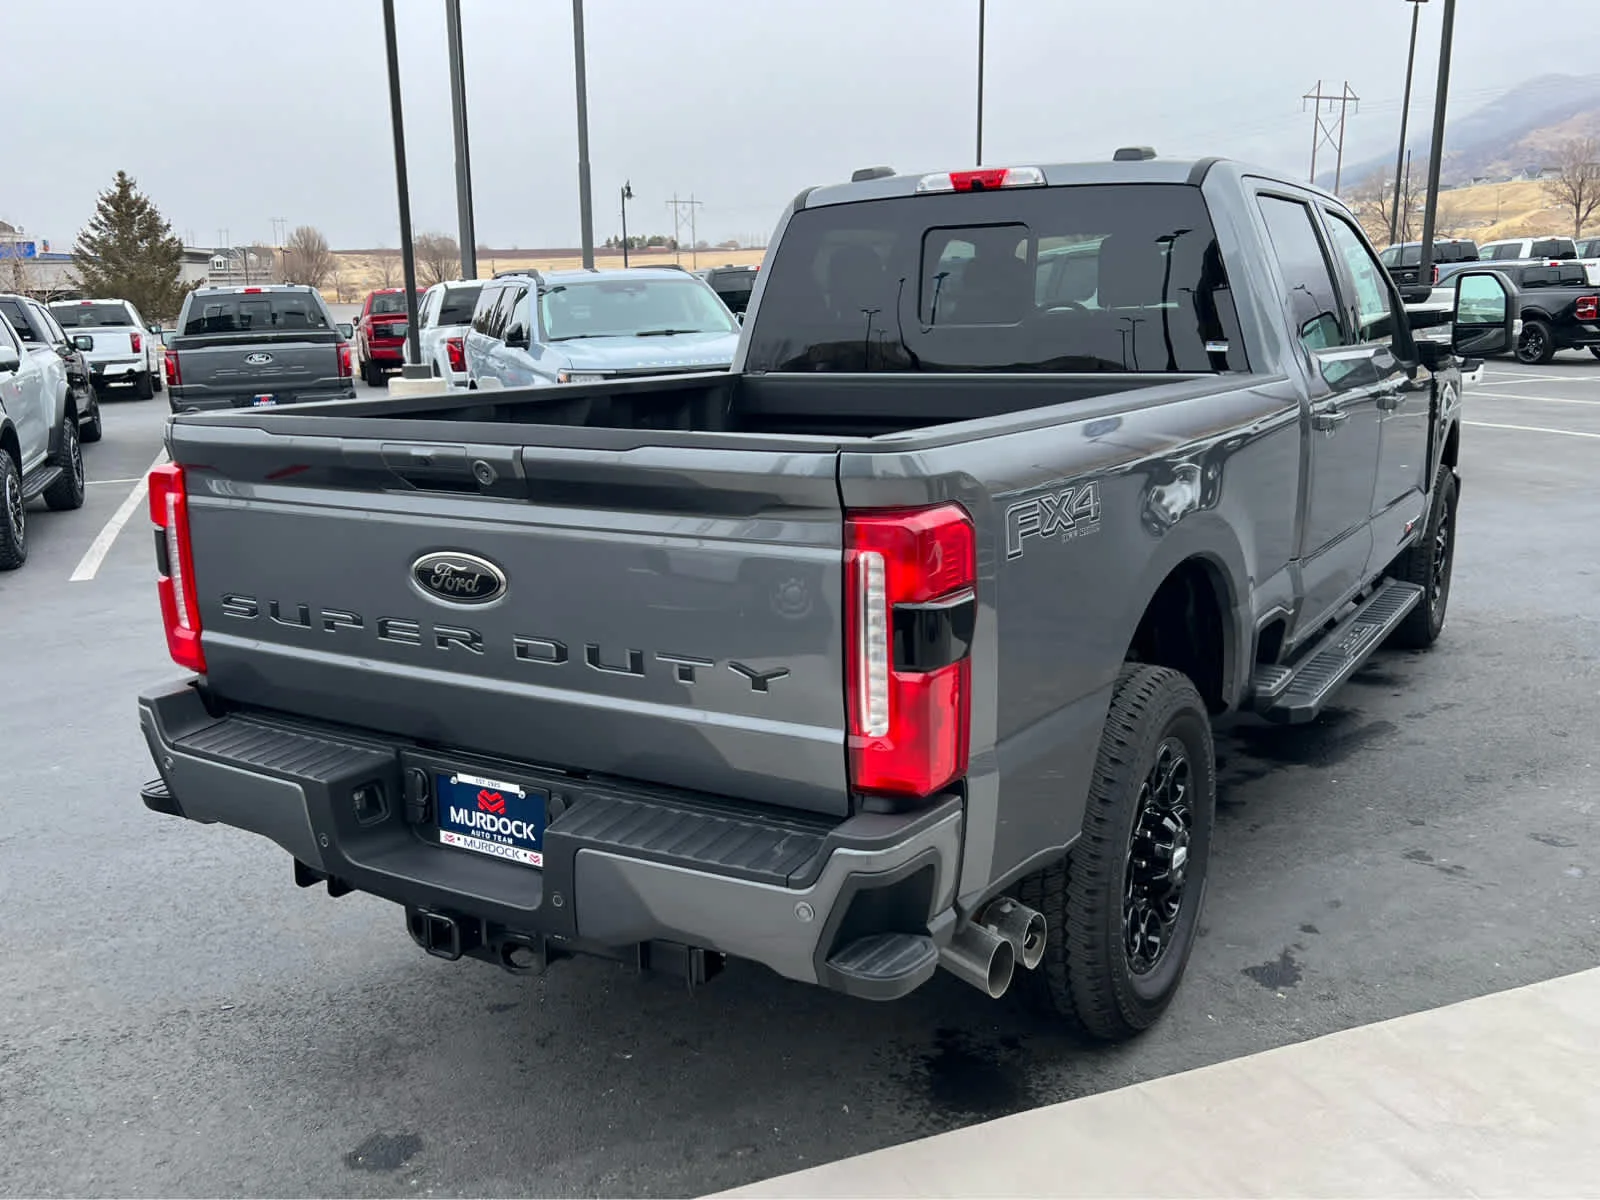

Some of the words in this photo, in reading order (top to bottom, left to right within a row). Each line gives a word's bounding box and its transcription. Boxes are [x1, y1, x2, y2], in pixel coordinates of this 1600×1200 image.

[1005, 480, 1101, 561] FX4
[431, 562, 480, 592] Ford
[221, 592, 484, 655] SUPER
[513, 634, 790, 693] DUTY
[449, 805, 536, 841] MURDOCK
[471, 829, 490, 839] AUTO
[493, 834, 513, 845] TEAM
[463, 837, 521, 860] MURDOCK
